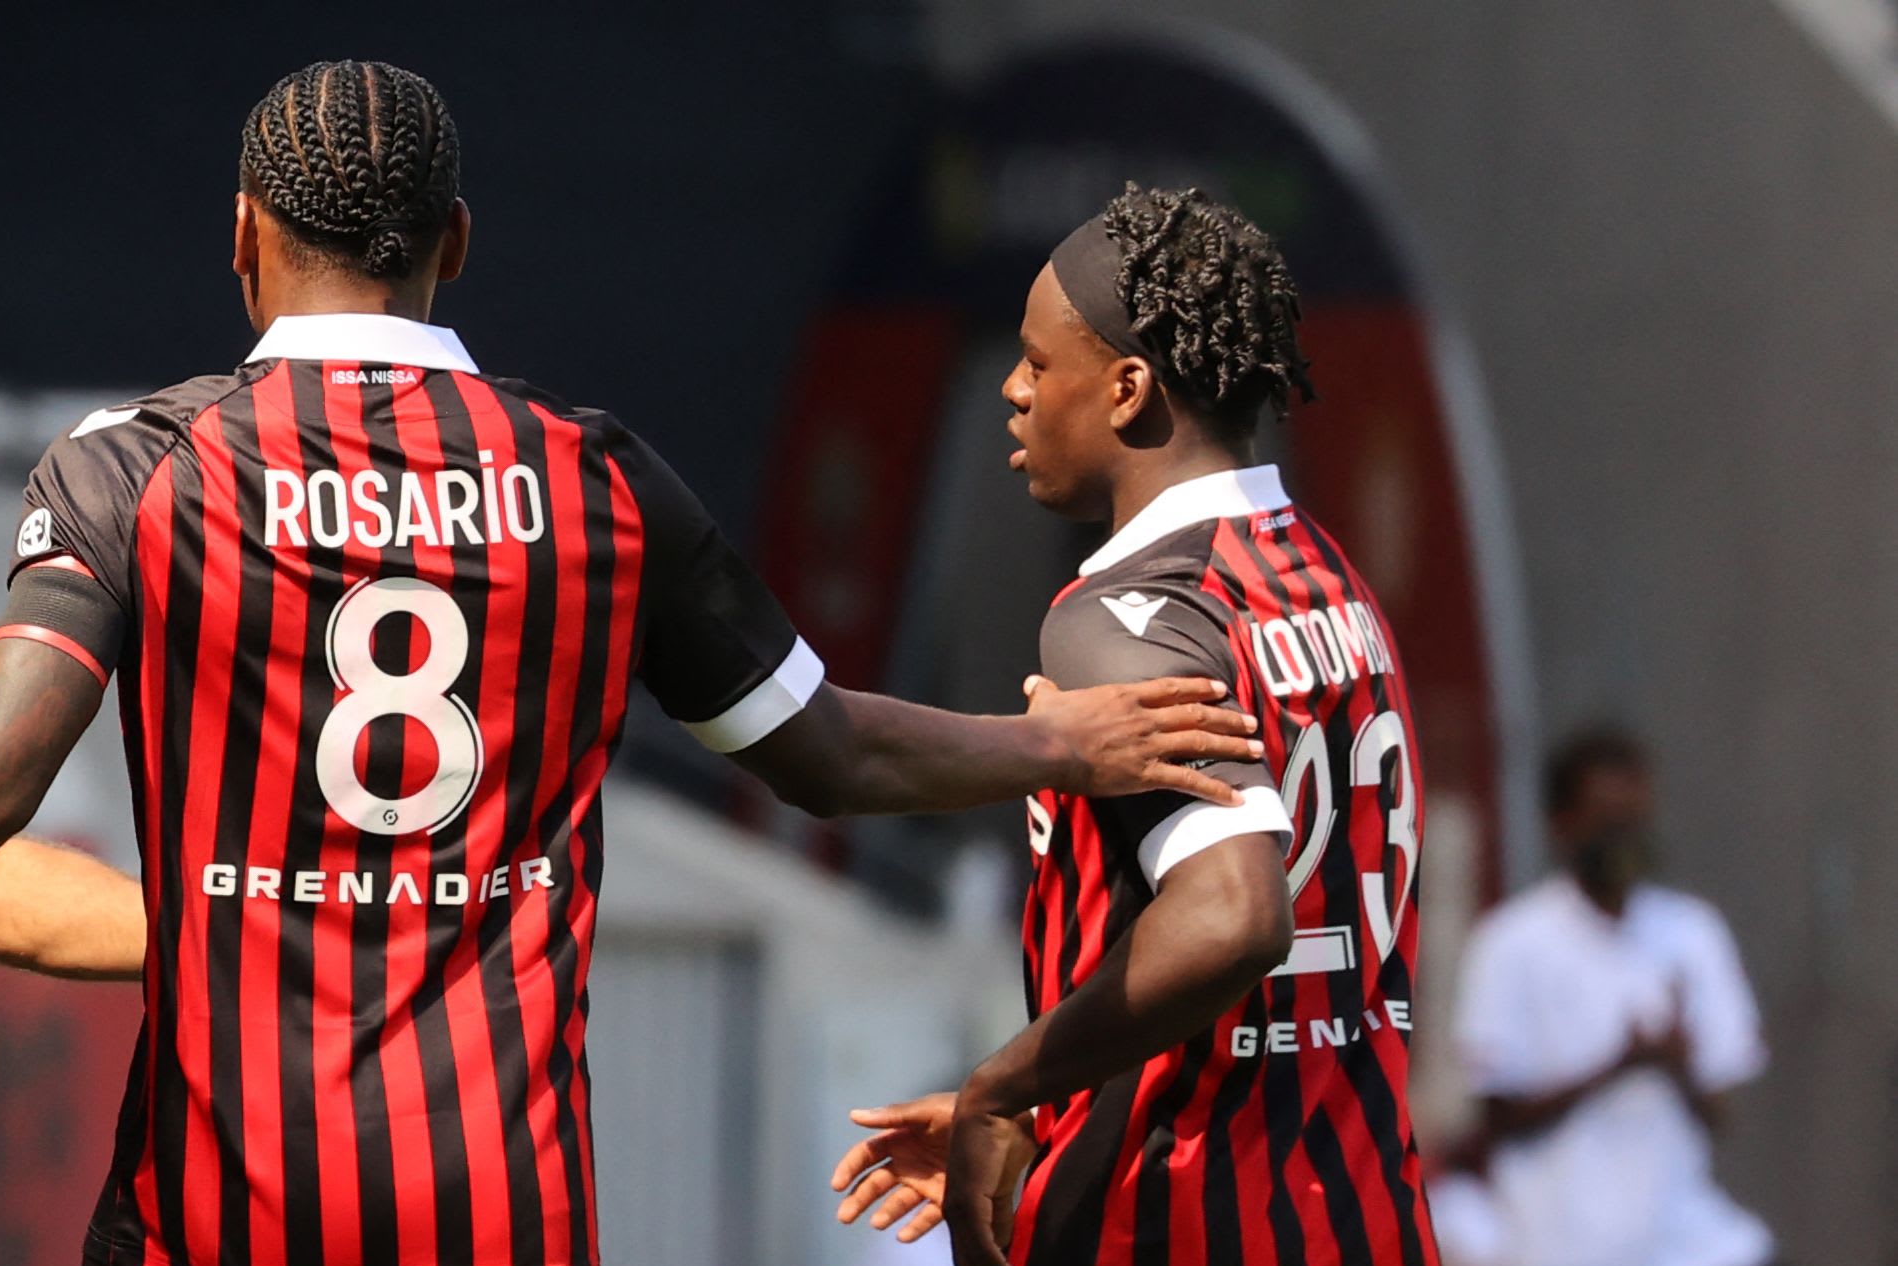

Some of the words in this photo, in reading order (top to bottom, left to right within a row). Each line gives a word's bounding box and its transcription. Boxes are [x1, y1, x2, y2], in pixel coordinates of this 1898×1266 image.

[331, 370, 369, 385] ISSA
[371, 370, 418, 384] NISSA
[316, 575, 485, 836] 8
[202, 856, 555, 906] GRENADIER
[1266, 711, 1419, 977] 23
